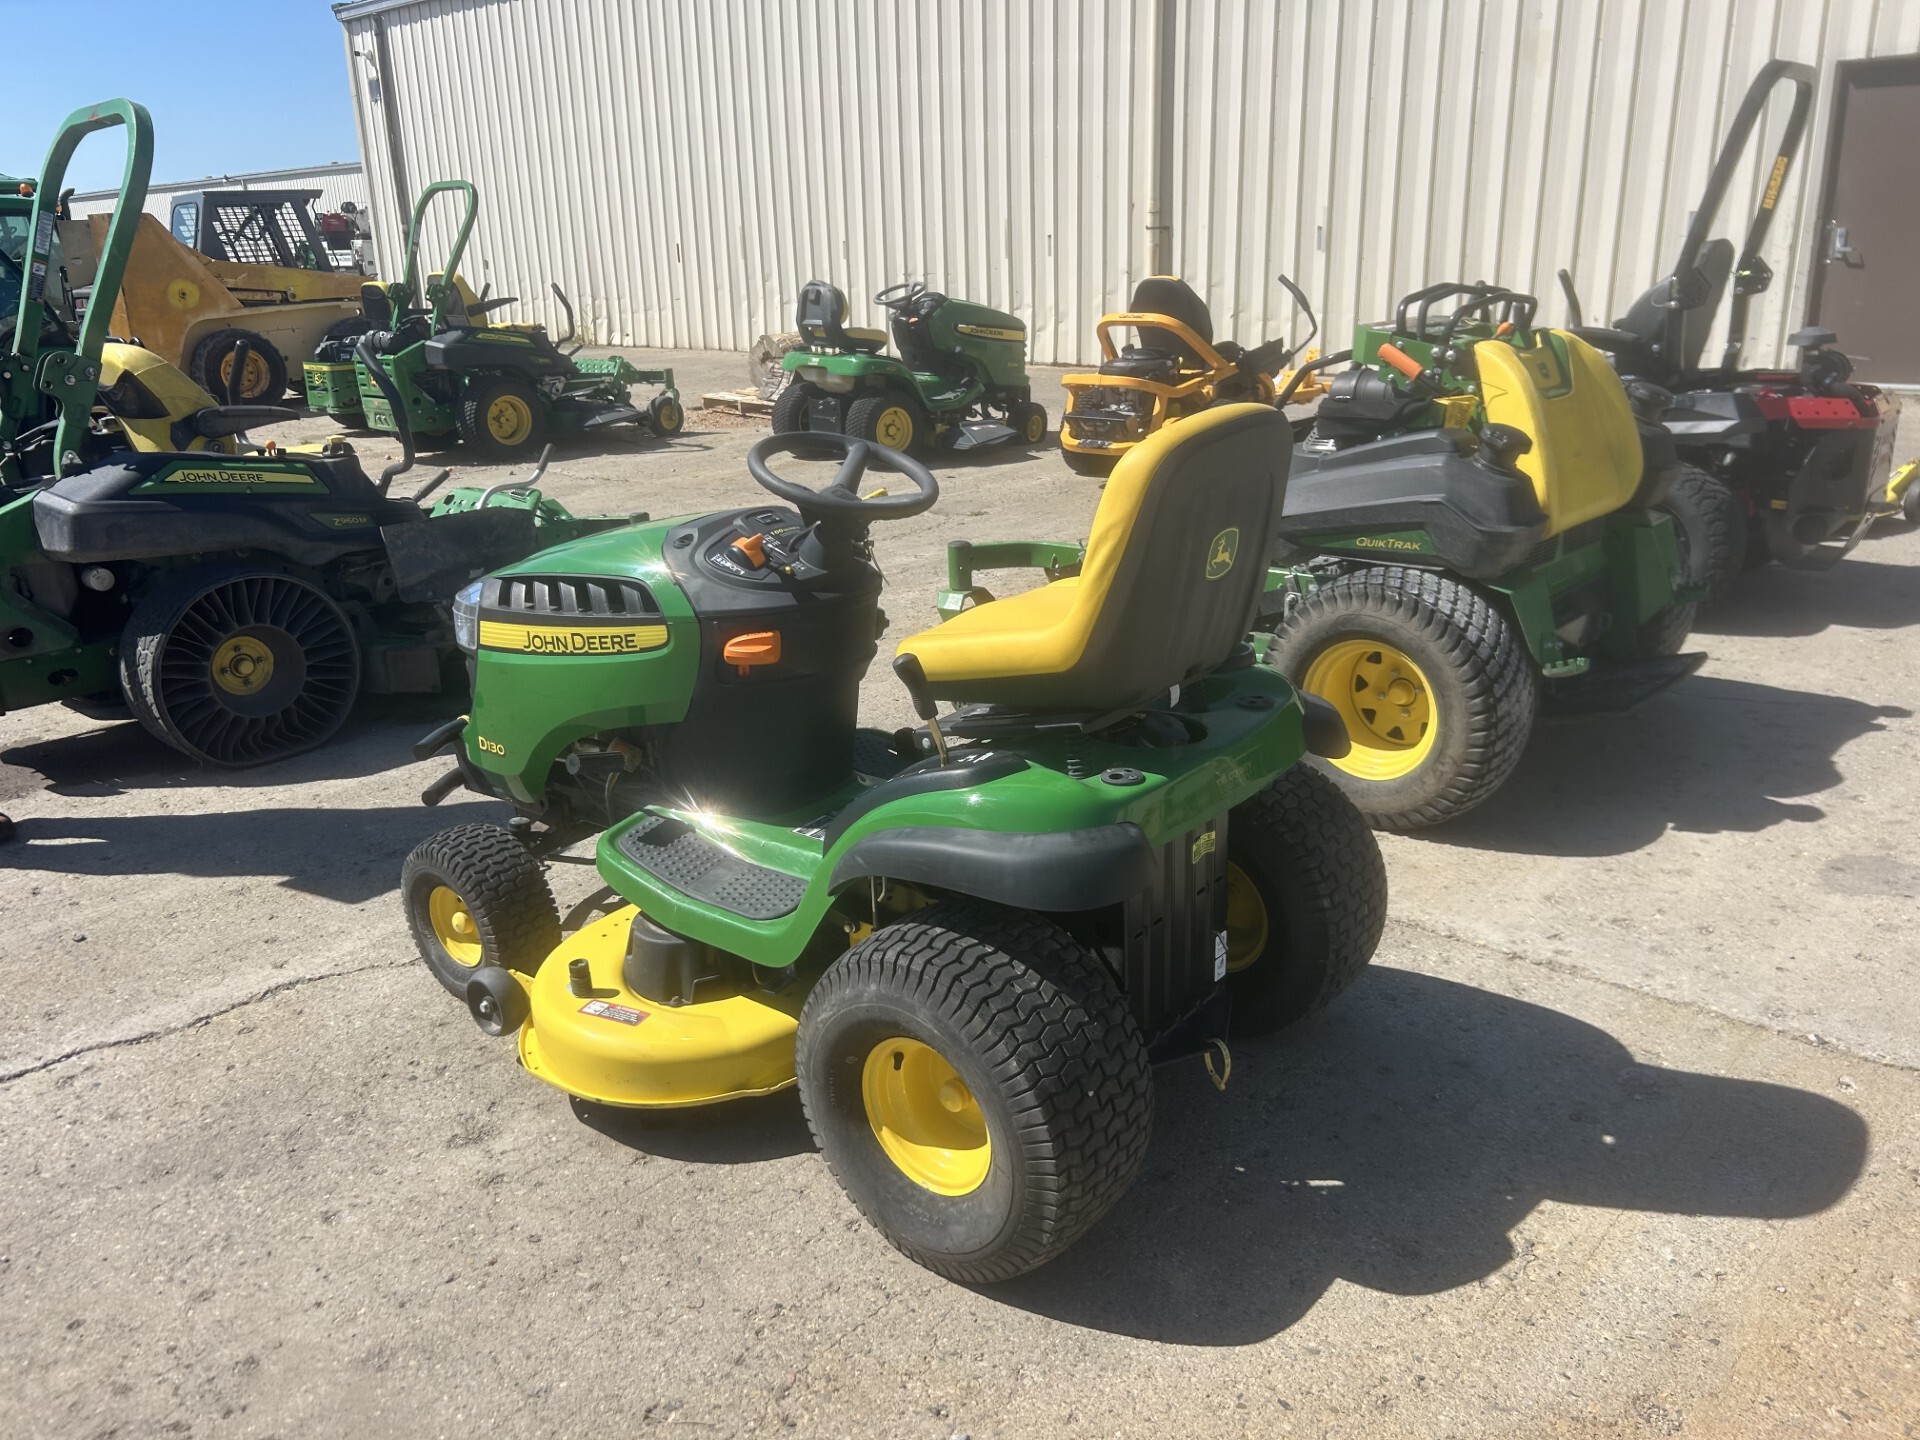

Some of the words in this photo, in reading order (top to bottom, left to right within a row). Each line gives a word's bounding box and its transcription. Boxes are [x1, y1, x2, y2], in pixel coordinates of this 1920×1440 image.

[180, 471, 217, 482] JOHN
[219, 471, 265, 482] DEERE
[523, 630, 568, 651] JOHN
[570, 632, 638, 650] DEERE
[478, 735, 505, 756] D130
